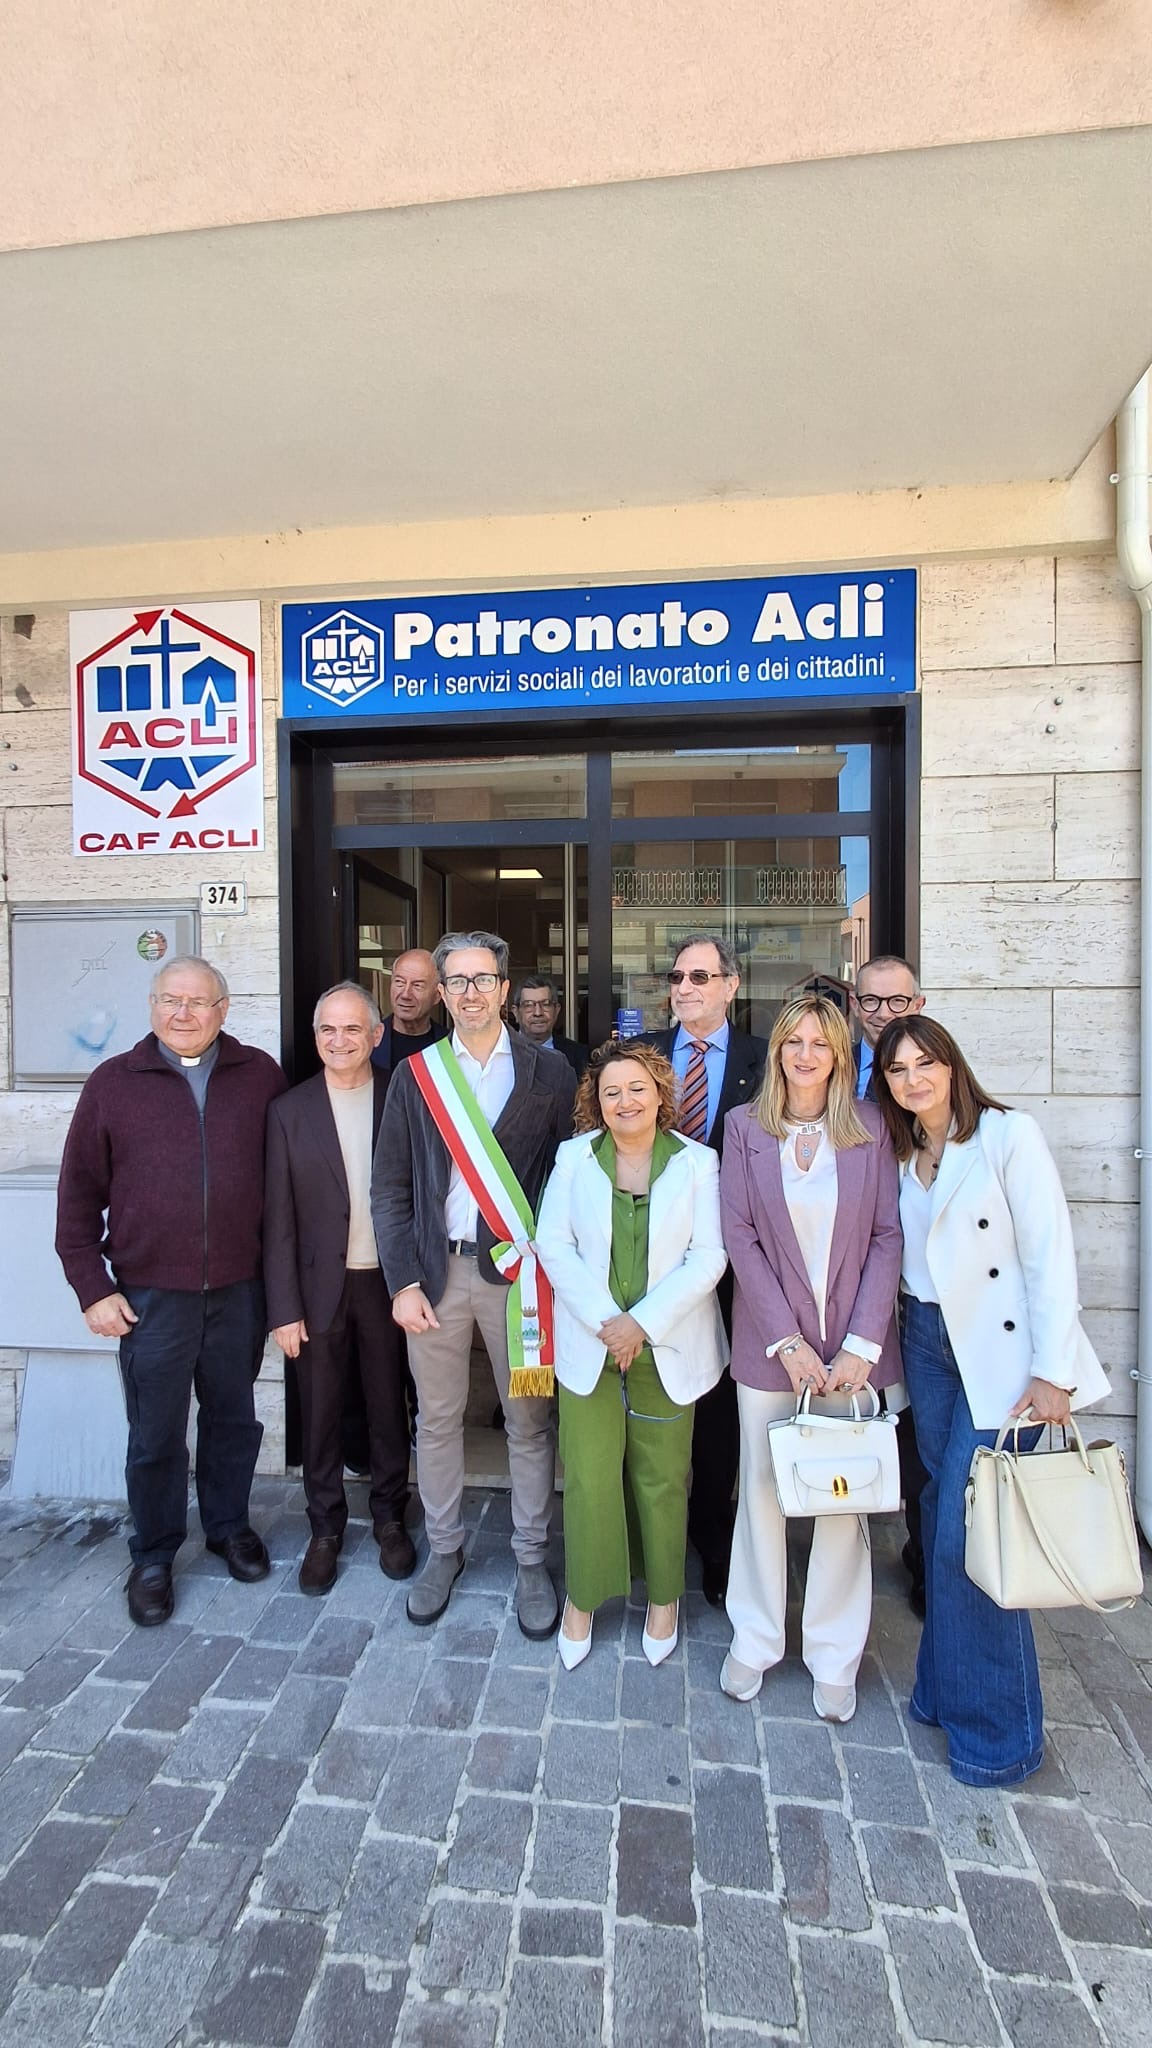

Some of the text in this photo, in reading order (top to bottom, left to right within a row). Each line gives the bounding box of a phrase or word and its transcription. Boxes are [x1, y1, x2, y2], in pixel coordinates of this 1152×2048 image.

[394, 583, 885, 660] Patronato Acli
[312, 659, 376, 676] ACLI
[394, 652, 885, 698] Per i servizi sociali dei lavoratori e dei cittadini
[98, 716, 238, 750] ACLI
[79, 829, 259, 853] CAF ACLI
[208, 886, 238, 905] 374
